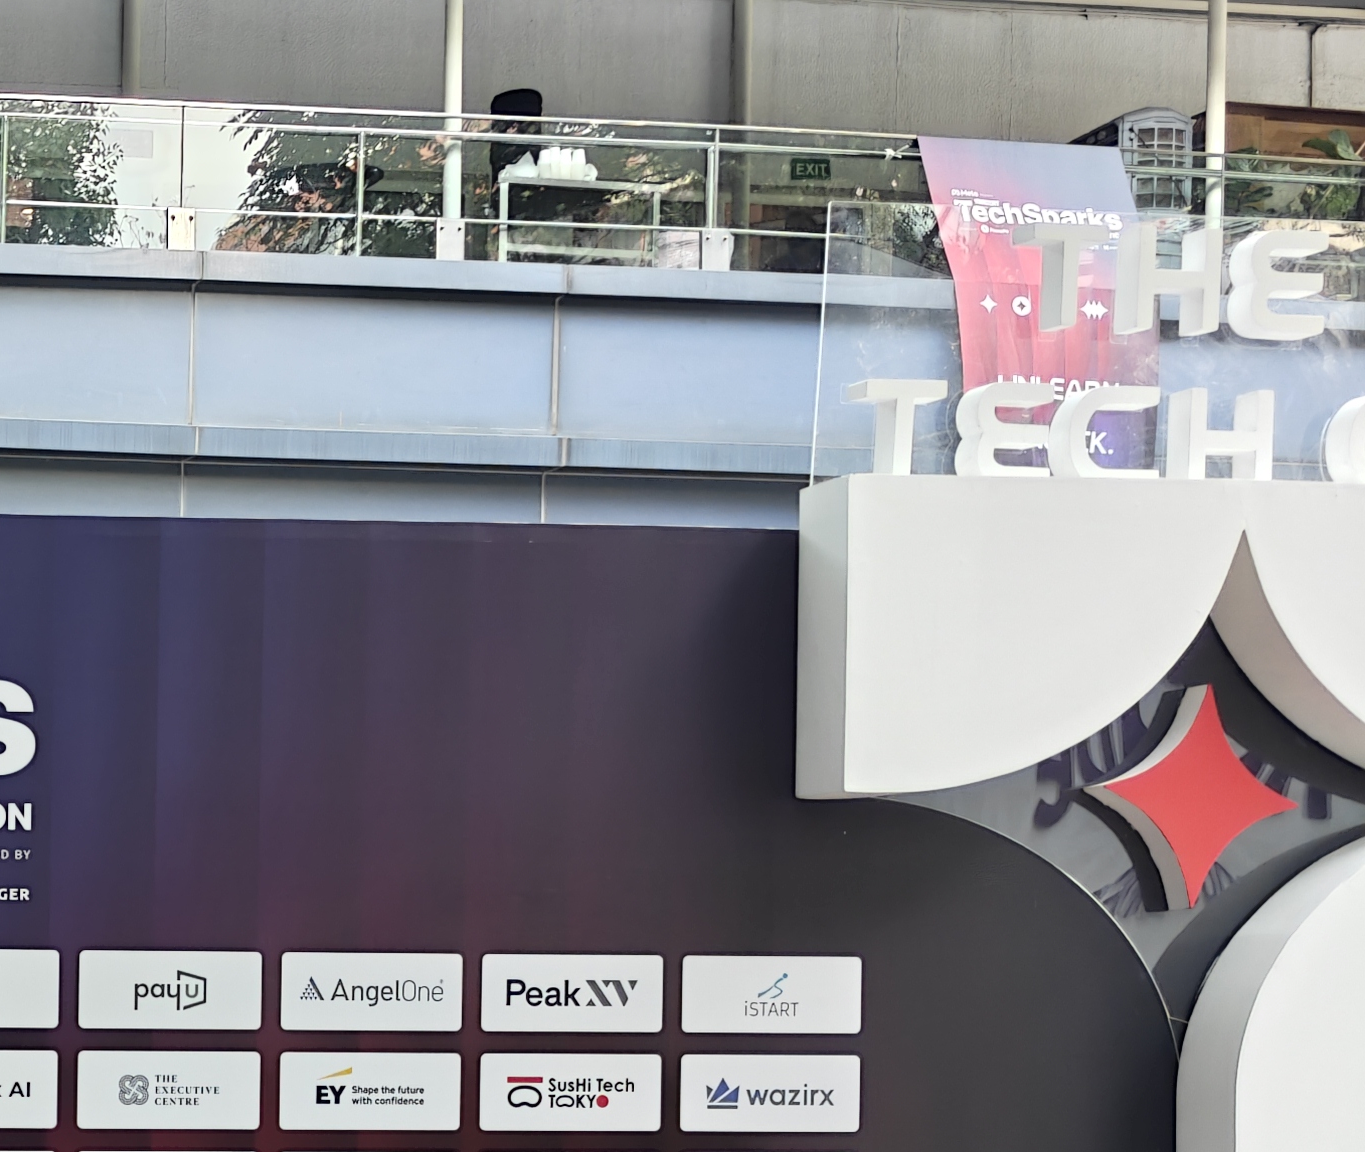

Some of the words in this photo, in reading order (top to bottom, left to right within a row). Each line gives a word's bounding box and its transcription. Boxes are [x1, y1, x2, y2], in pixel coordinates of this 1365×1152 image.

[795, 161, 828, 178] EXIT
[1012, 223, 1330, 341] THE
[847, 379, 1275, 480] TECH
[13, 849, 31, 861] BY
[331, 980, 443, 1007] AngelOne
[505, 979, 581, 1008] Peak
[585, 980, 638, 1007] XV
[743, 1001, 799, 1018] iSTART
[155, 1075, 177, 1084] THE
[597, 1078, 635, 1092] Tech
[9, 1082, 31, 1098] AI
[155, 1086, 220, 1095] EXECUTIVE
[315, 1086, 346, 1104] EY
[351, 1086, 379, 1096] Shape
[381, 1086, 395, 1094] the
[397, 1086, 425, 1094] future
[747, 1084, 835, 1106] wazirx
[155, 1097, 200, 1106] CENTRE
[351, 1096, 372, 1105] with
[374, 1096, 425, 1105] confidence
